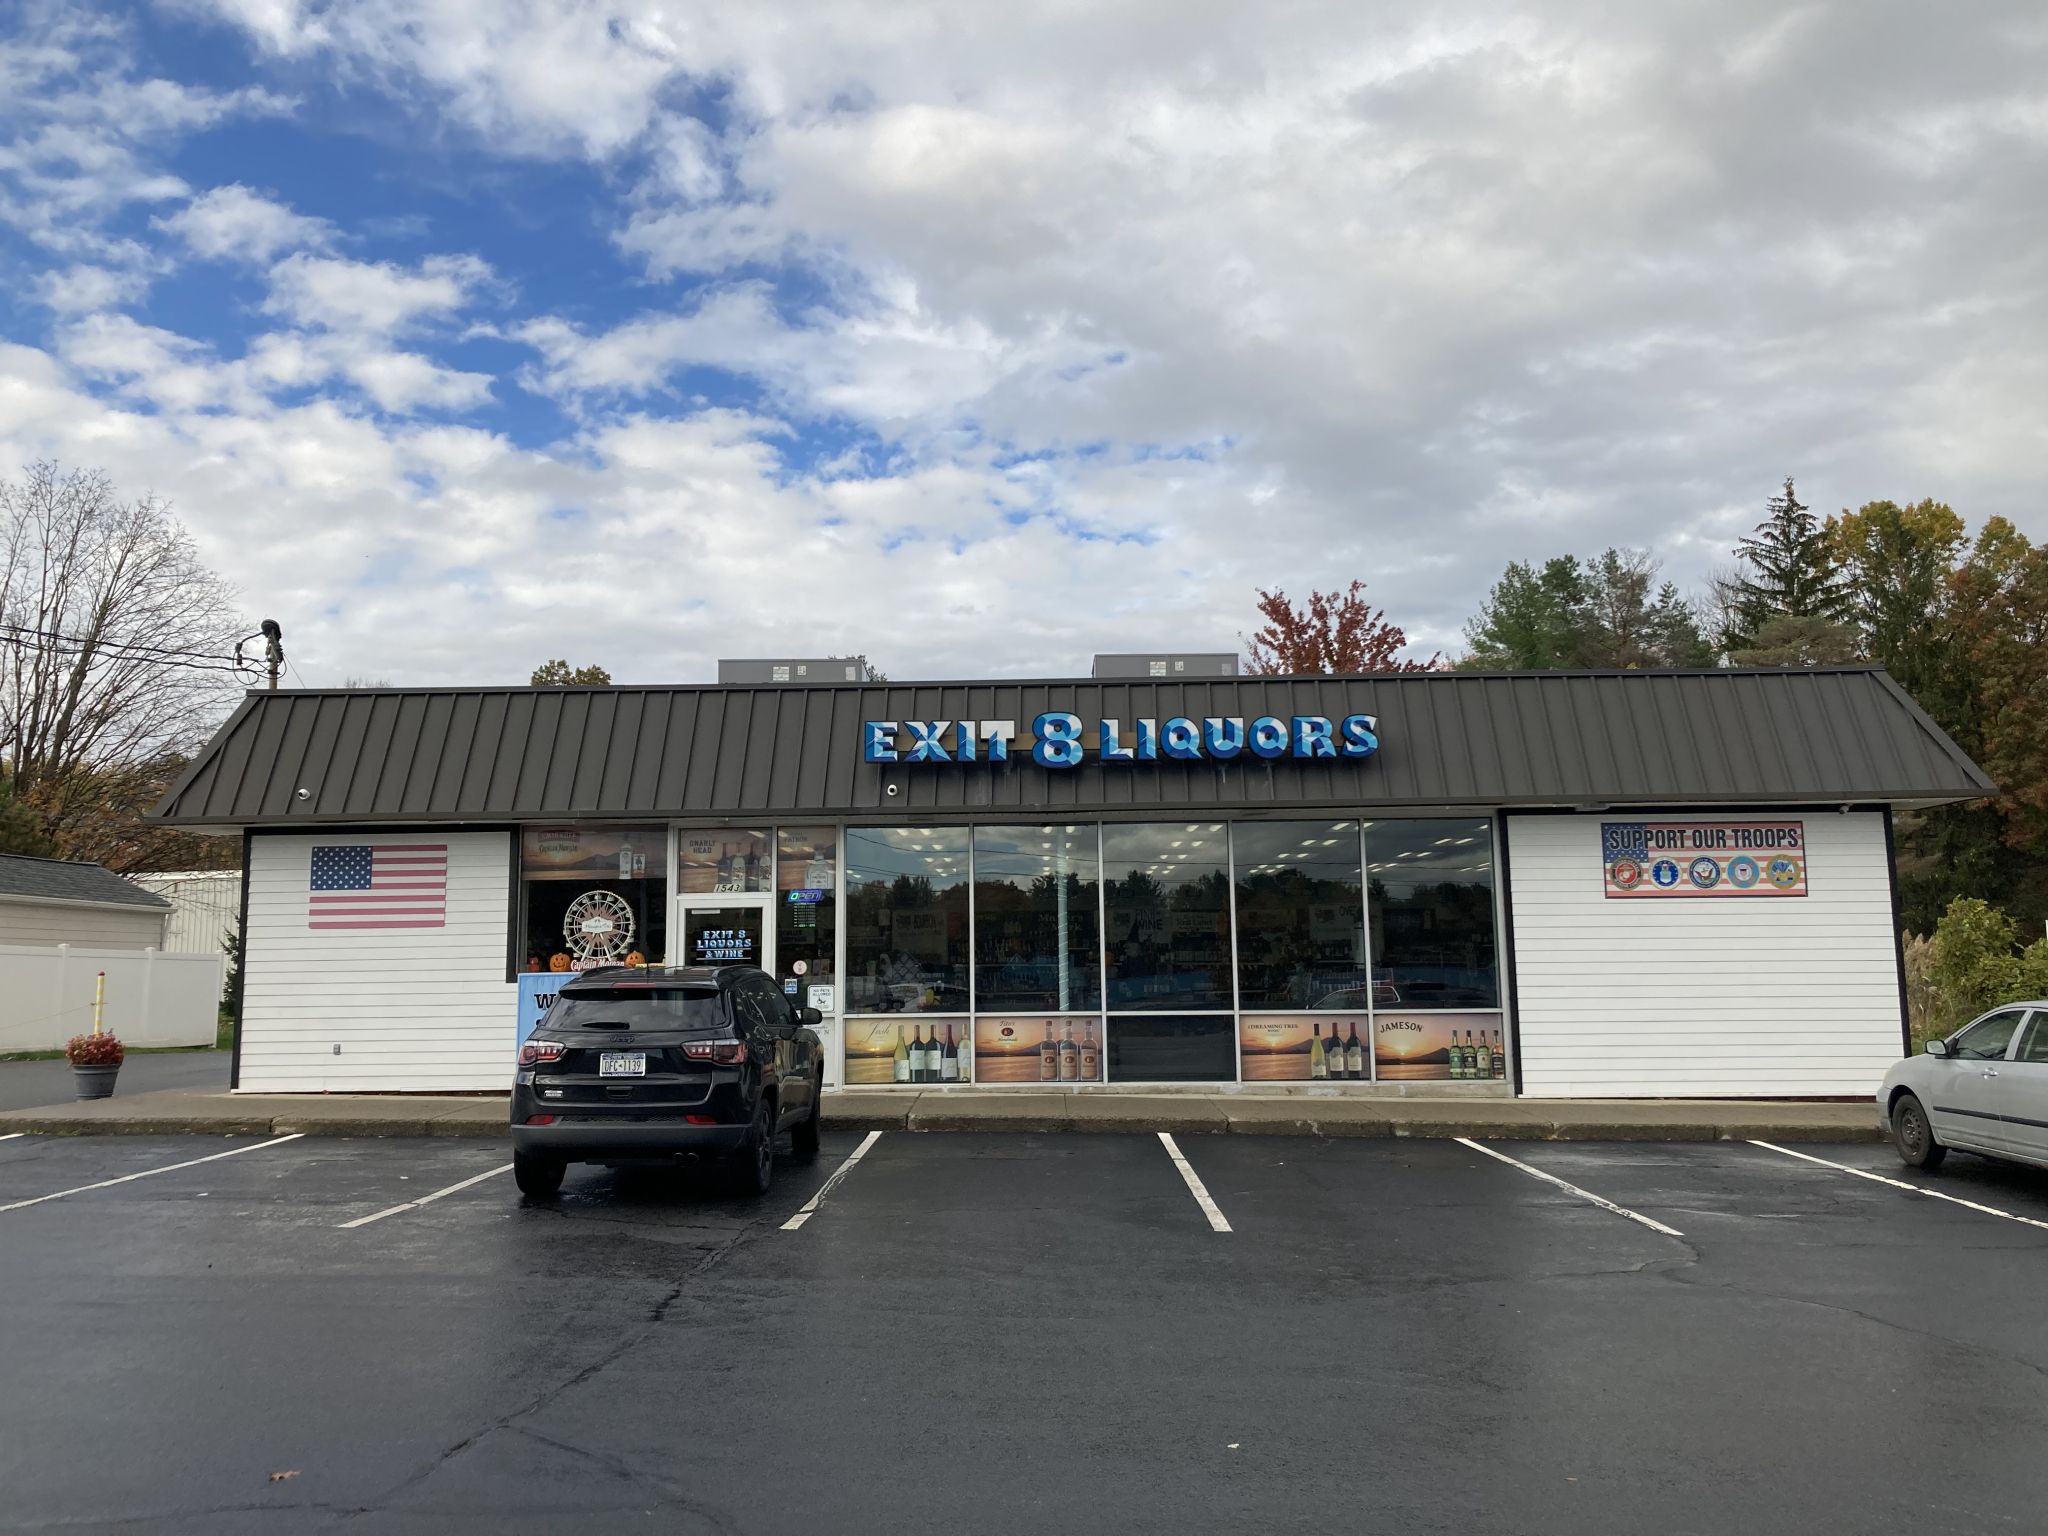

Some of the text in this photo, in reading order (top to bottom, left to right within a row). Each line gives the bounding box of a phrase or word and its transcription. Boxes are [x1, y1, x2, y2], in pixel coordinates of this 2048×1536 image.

[864, 711, 1379, 769] EXIT 8 LIQUORS
[1609, 828, 1799, 850] SUPPORT OUR TROOPS
[716, 884, 740, 892] 1543
[703, 931, 733, 939] EXIT
[697, 939, 752, 948] LIQUORS
[714, 950, 743, 958] WINE
[570, 959, 596, 971] Captain
[1380, 1021, 1423, 1033] JAMESON
[610, 1034, 635, 1044] Jeep
